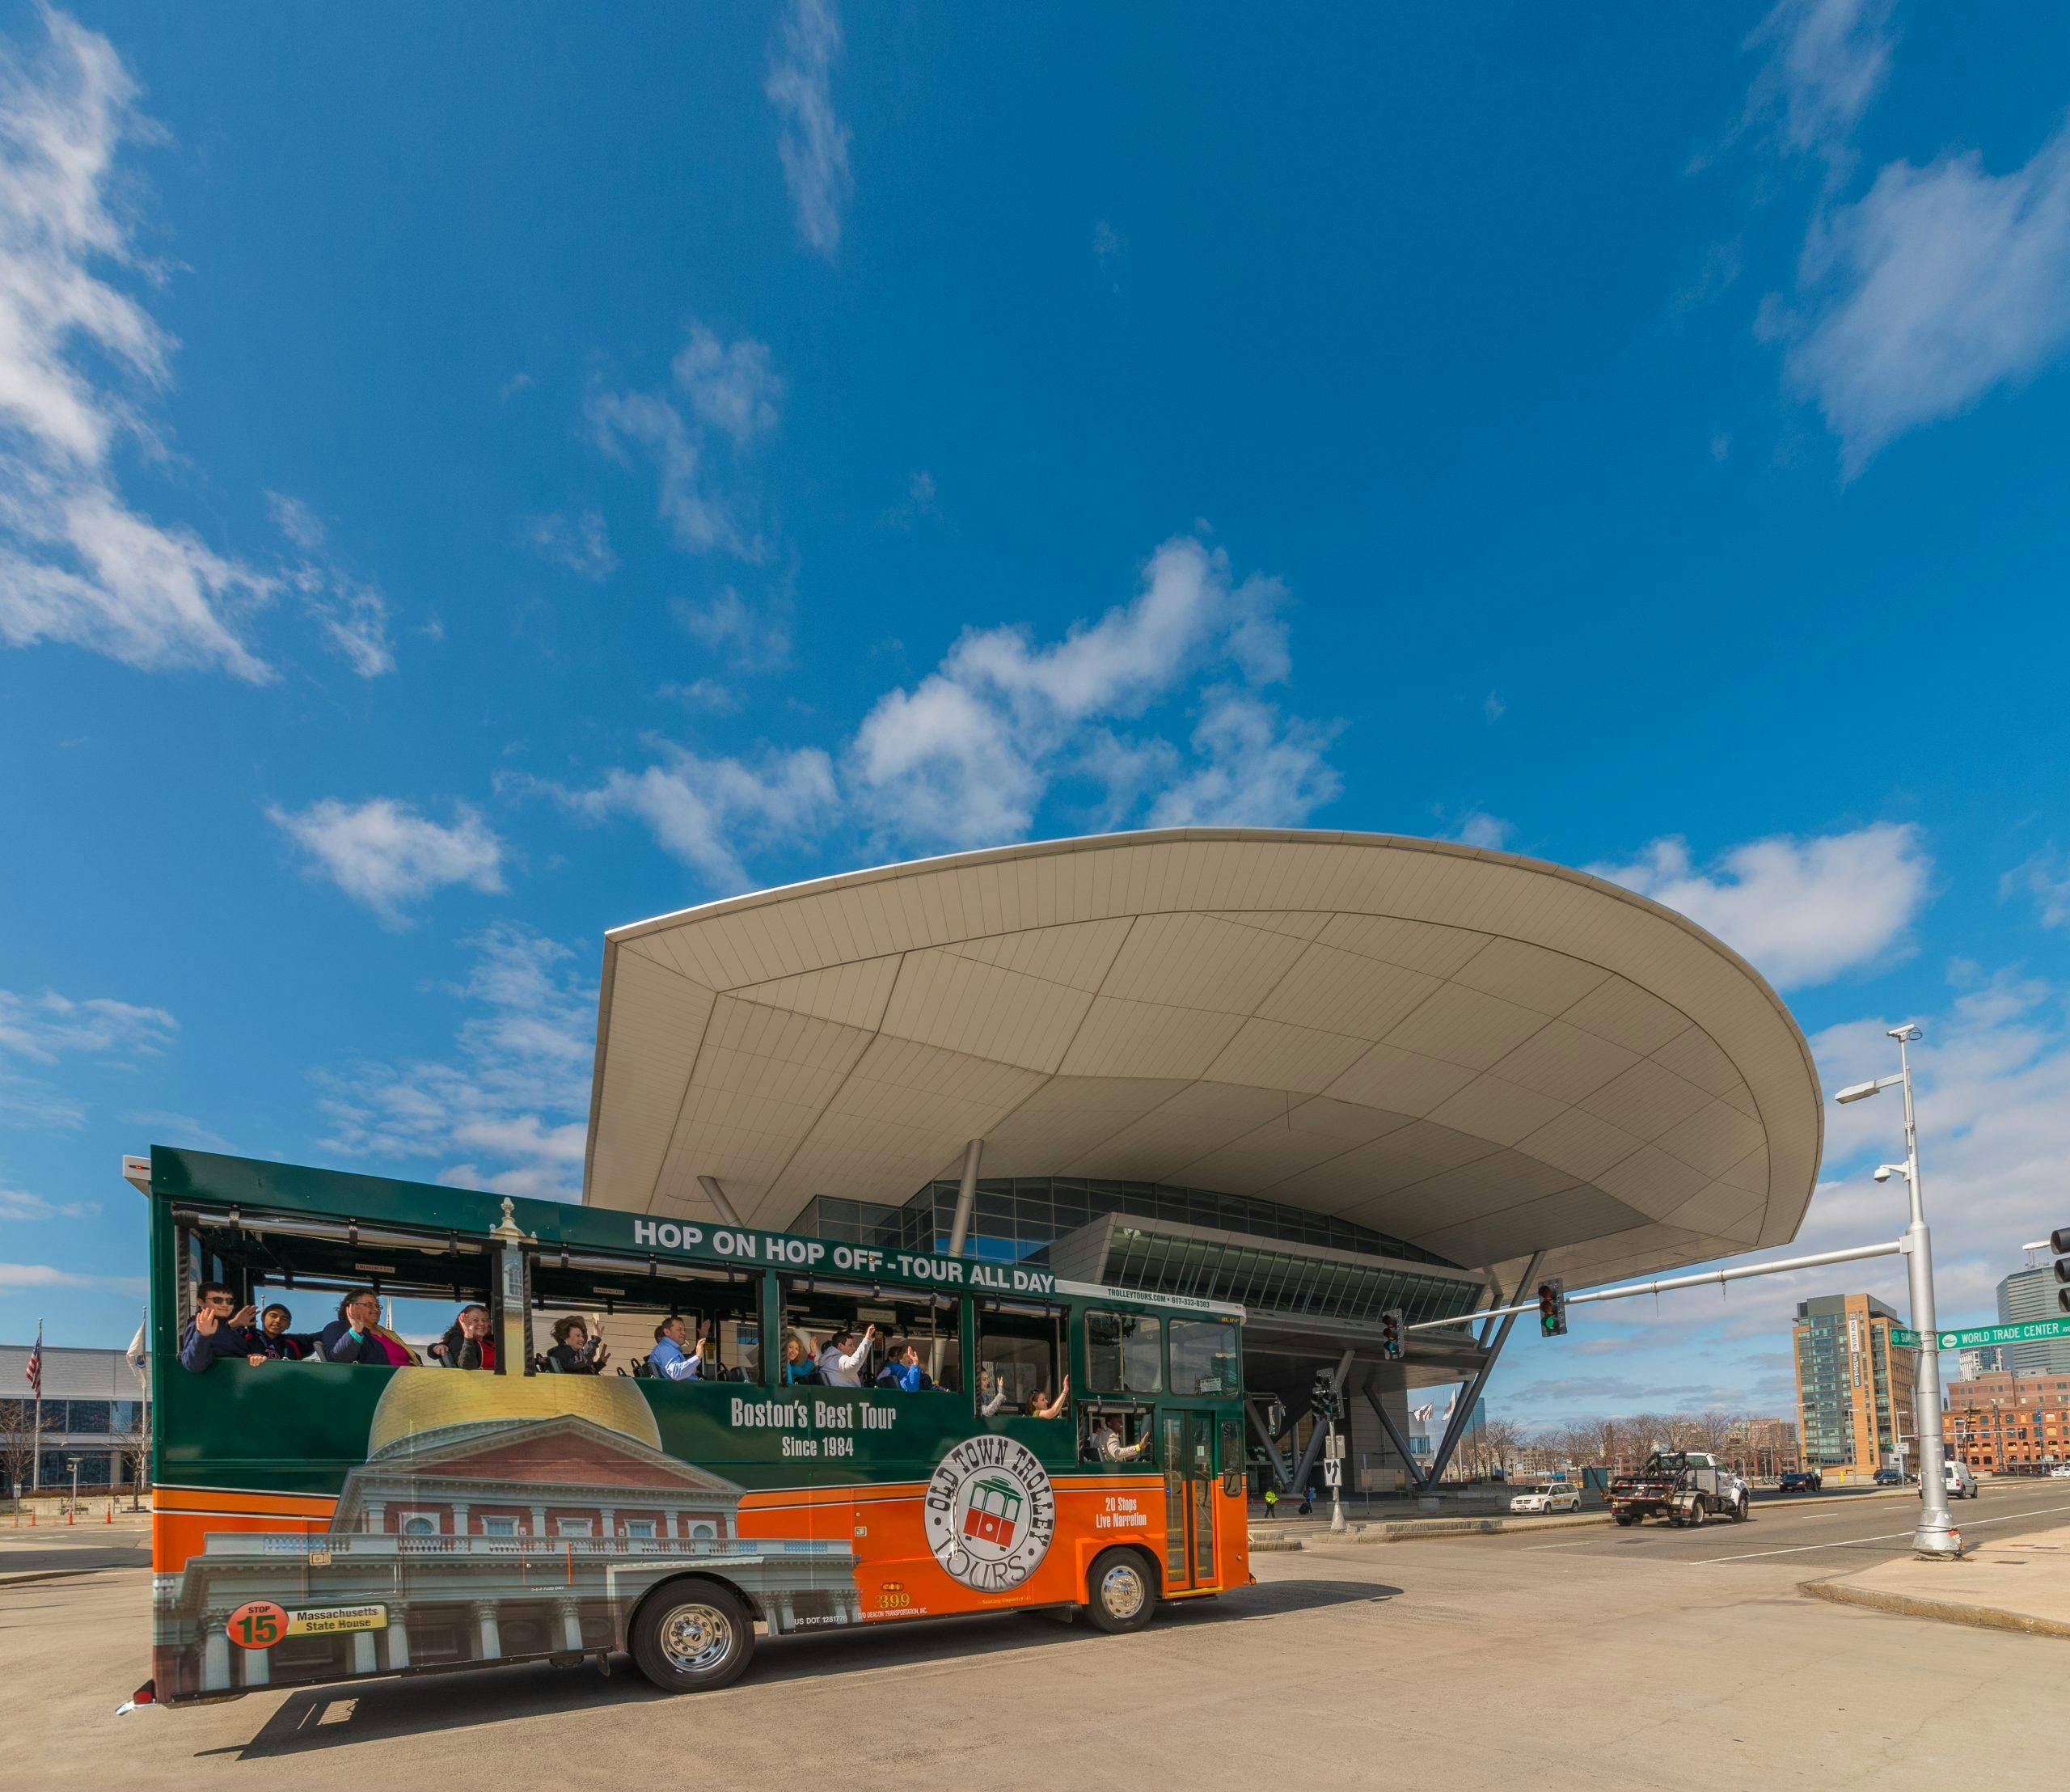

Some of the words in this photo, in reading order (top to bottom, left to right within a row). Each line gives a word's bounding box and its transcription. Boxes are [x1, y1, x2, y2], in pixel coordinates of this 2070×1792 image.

[635, 1219, 703, 1249] HOP
[713, 1231, 756, 1258] ON
[766, 1237, 825, 1264] HOP
[833, 1246, 883, 1271] OFF
[969, 1265, 1010, 1289] ALL
[1013, 1270, 1054, 1293] DAY
[1108, 1288, 1166, 1303] TROLLEYTOURS.COM
[1961, 1332, 1990, 1344] WORLD
[1992, 1327, 2021, 1341] TRADE
[2024, 1322, 2059, 1337] CENTER
[731, 1397, 808, 1428] Boston's
[815, 1401, 853, 1429] Best
[859, 1402, 897, 1430] Tour
[782, 1436, 817, 1456] Since
[822, 1436, 854, 1456] 1984
[927, 1467, 959, 1511] OLD
[951, 1438, 1009, 1474] TOWN
[1012, 1446, 1054, 1548] TROLLEY
[1105, 1497, 1116, 1511] 20
[1117, 1496, 1137, 1513] Stops
[1096, 1513, 1111, 1528] Live
[1113, 1512, 1147, 1528] Narration
[934, 1528, 1027, 1591] TOURS
[879, 1592, 910, 1609] 399
[248, 1605, 271, 1614] STOP
[297, 1607, 379, 1621] Massachusetts
[237, 1614, 278, 1644] 15
[306, 1621, 336, 1632] State
[338, 1619, 371, 1629] House
[806, 1617, 820, 1625] DOT
